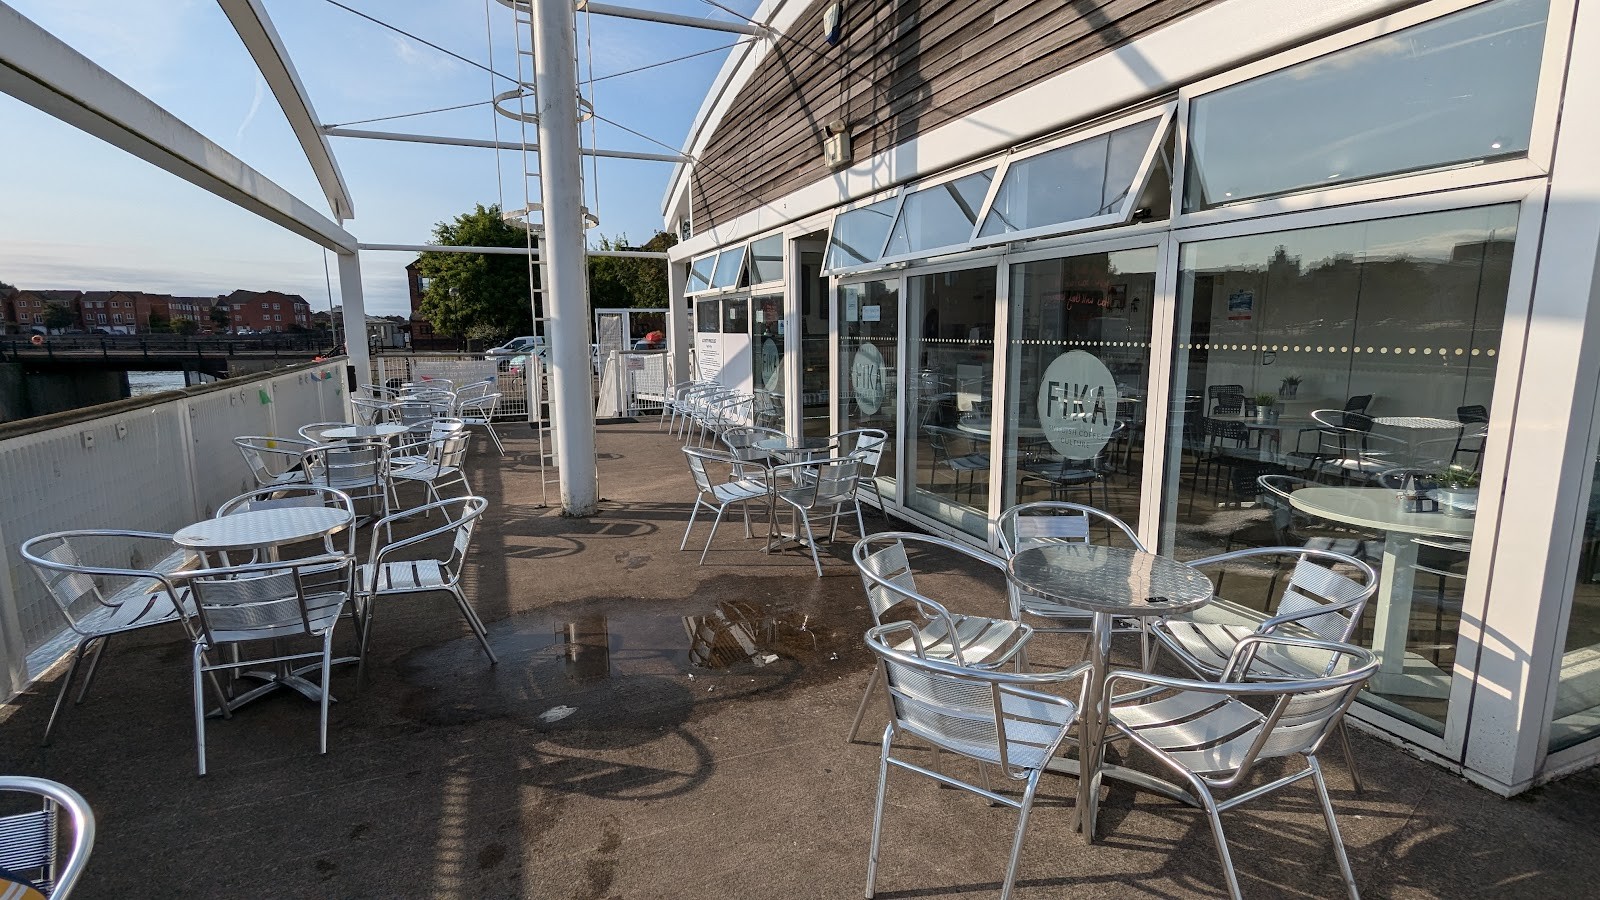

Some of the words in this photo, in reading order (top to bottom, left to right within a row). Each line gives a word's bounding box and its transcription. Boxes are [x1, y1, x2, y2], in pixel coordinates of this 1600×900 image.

[856, 364, 883, 392] FIKA
[1047, 381, 1108, 426] FIKA
[1049, 425, 1077, 436] SWDISH
[1078, 430, 1105, 441] COFFEE
[1060, 437, 1089, 449] CULTURE
